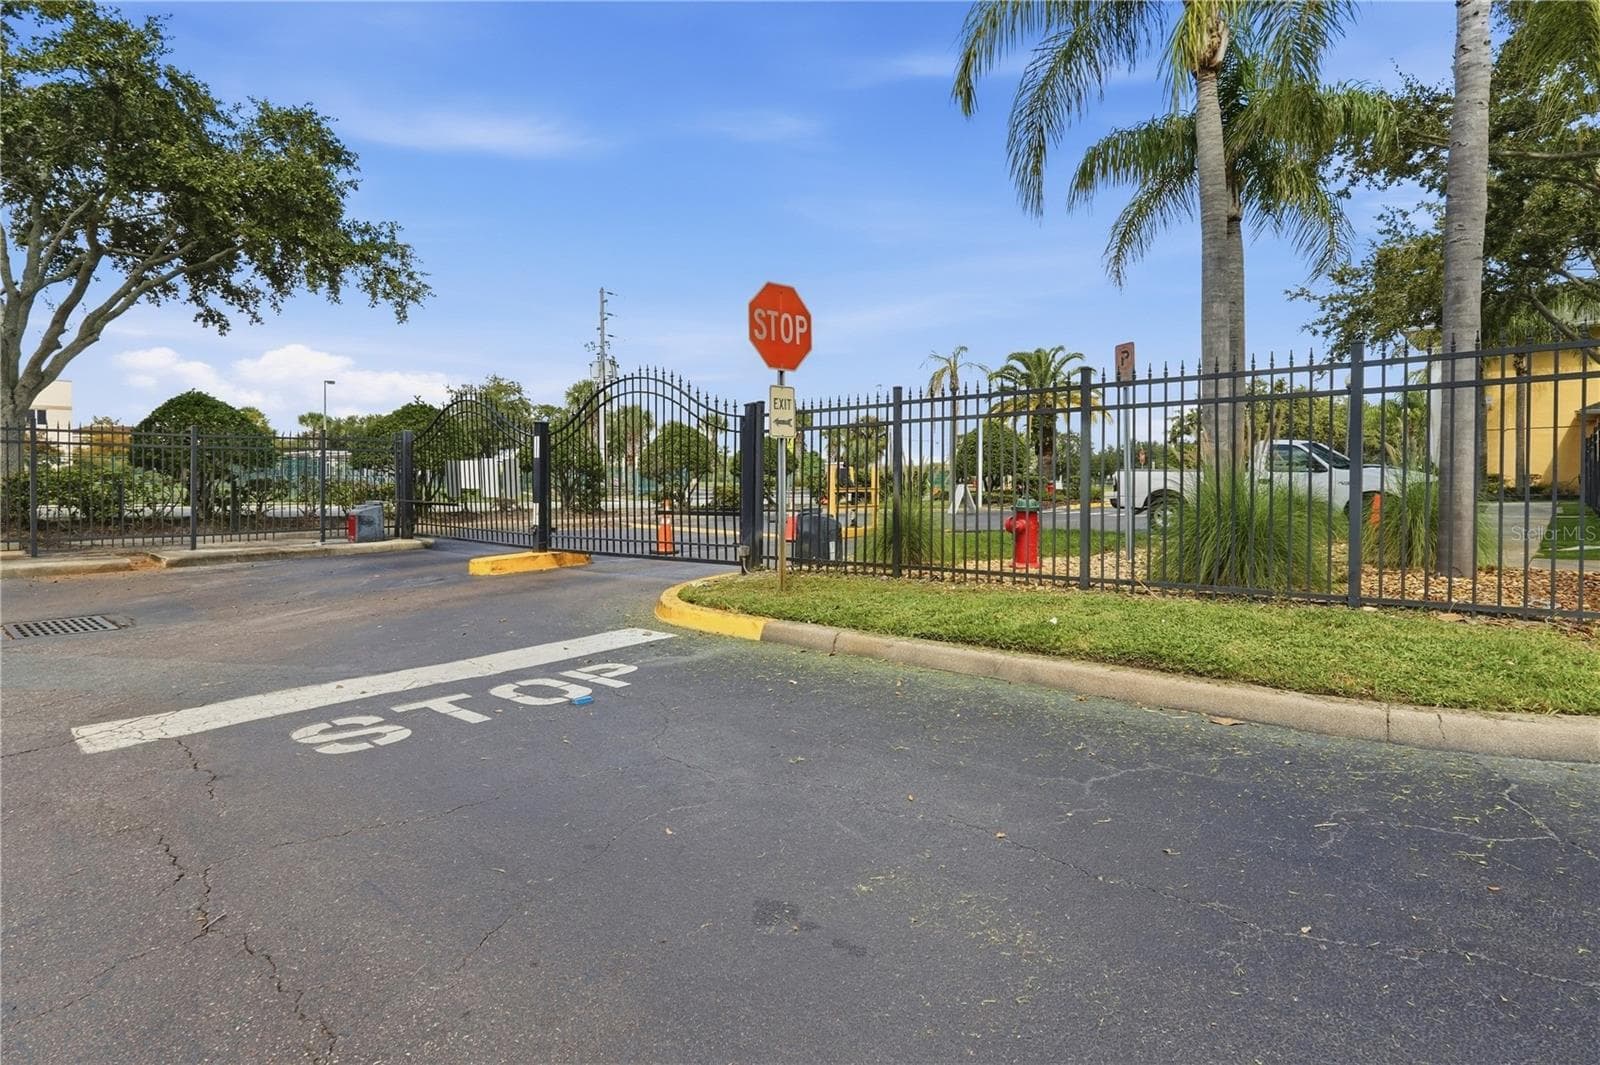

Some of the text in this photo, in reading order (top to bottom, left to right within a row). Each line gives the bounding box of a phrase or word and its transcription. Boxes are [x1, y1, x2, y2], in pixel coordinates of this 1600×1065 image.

[754, 308, 808, 345] STOP
[773, 397, 792, 411] EXIT
[290, 662, 639, 754] STOP
